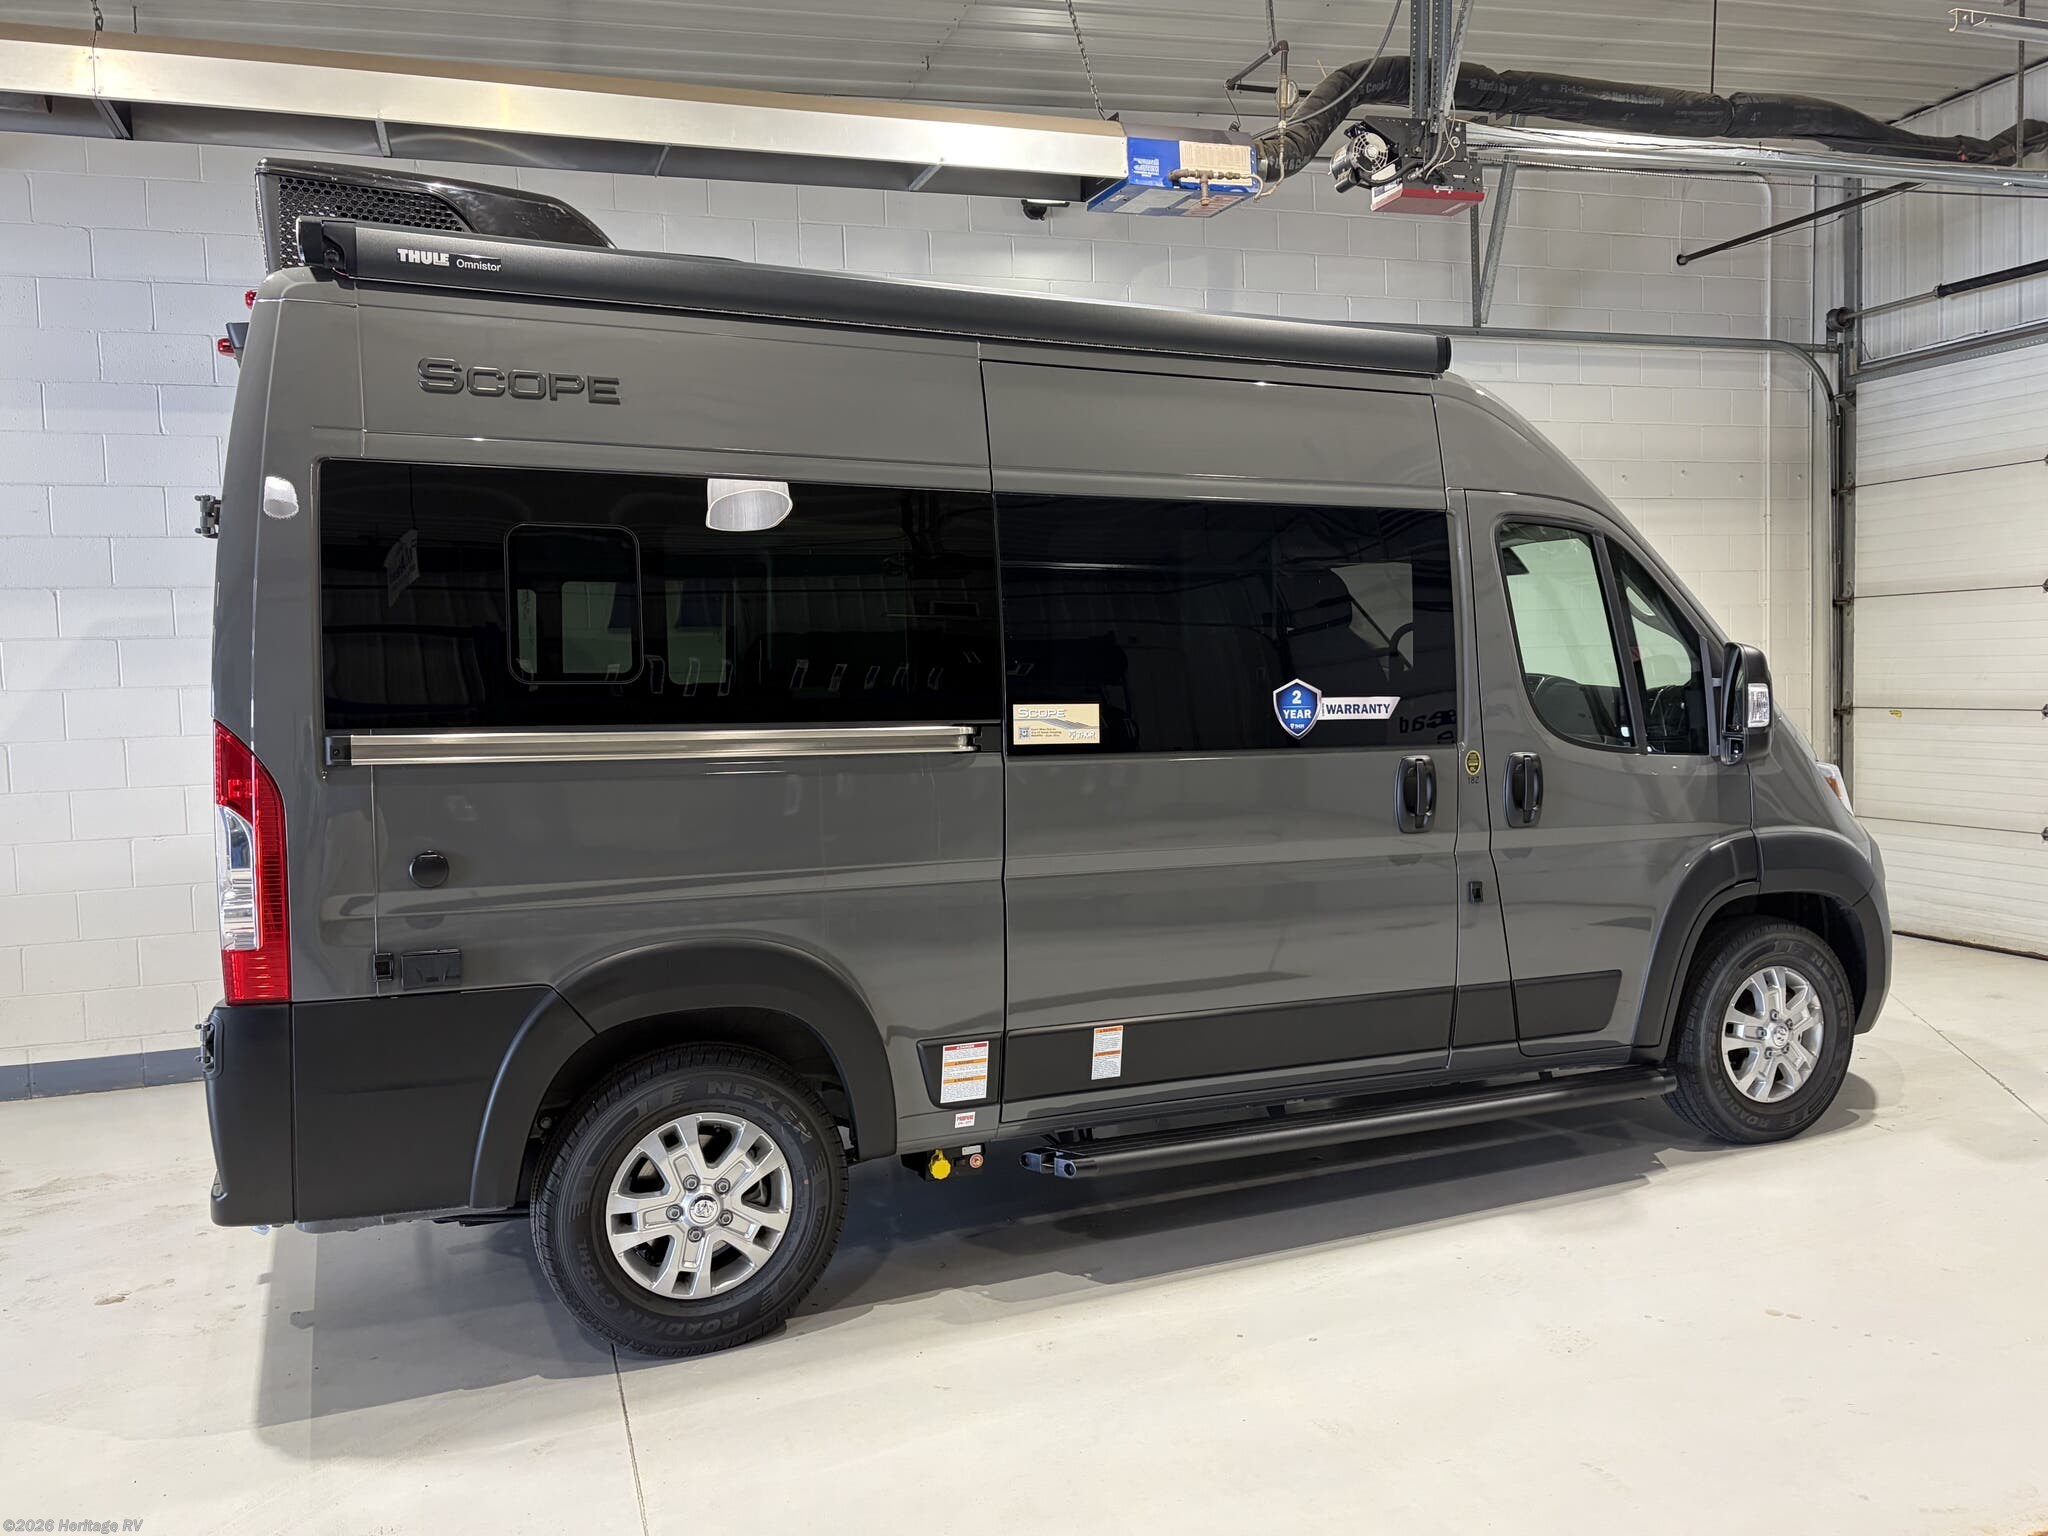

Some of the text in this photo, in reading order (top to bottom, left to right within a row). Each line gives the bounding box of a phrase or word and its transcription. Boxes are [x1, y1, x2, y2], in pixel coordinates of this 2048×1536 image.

[397, 248, 502, 272] THULE Omnistor
[417, 357, 621, 405] SCOPE
[1291, 690, 1302, 704] 2
[1018, 707, 1066, 719] SCOPE
[1283, 709, 1312, 719] YEAR
[1325, 703, 1391, 715] WARRANTY
